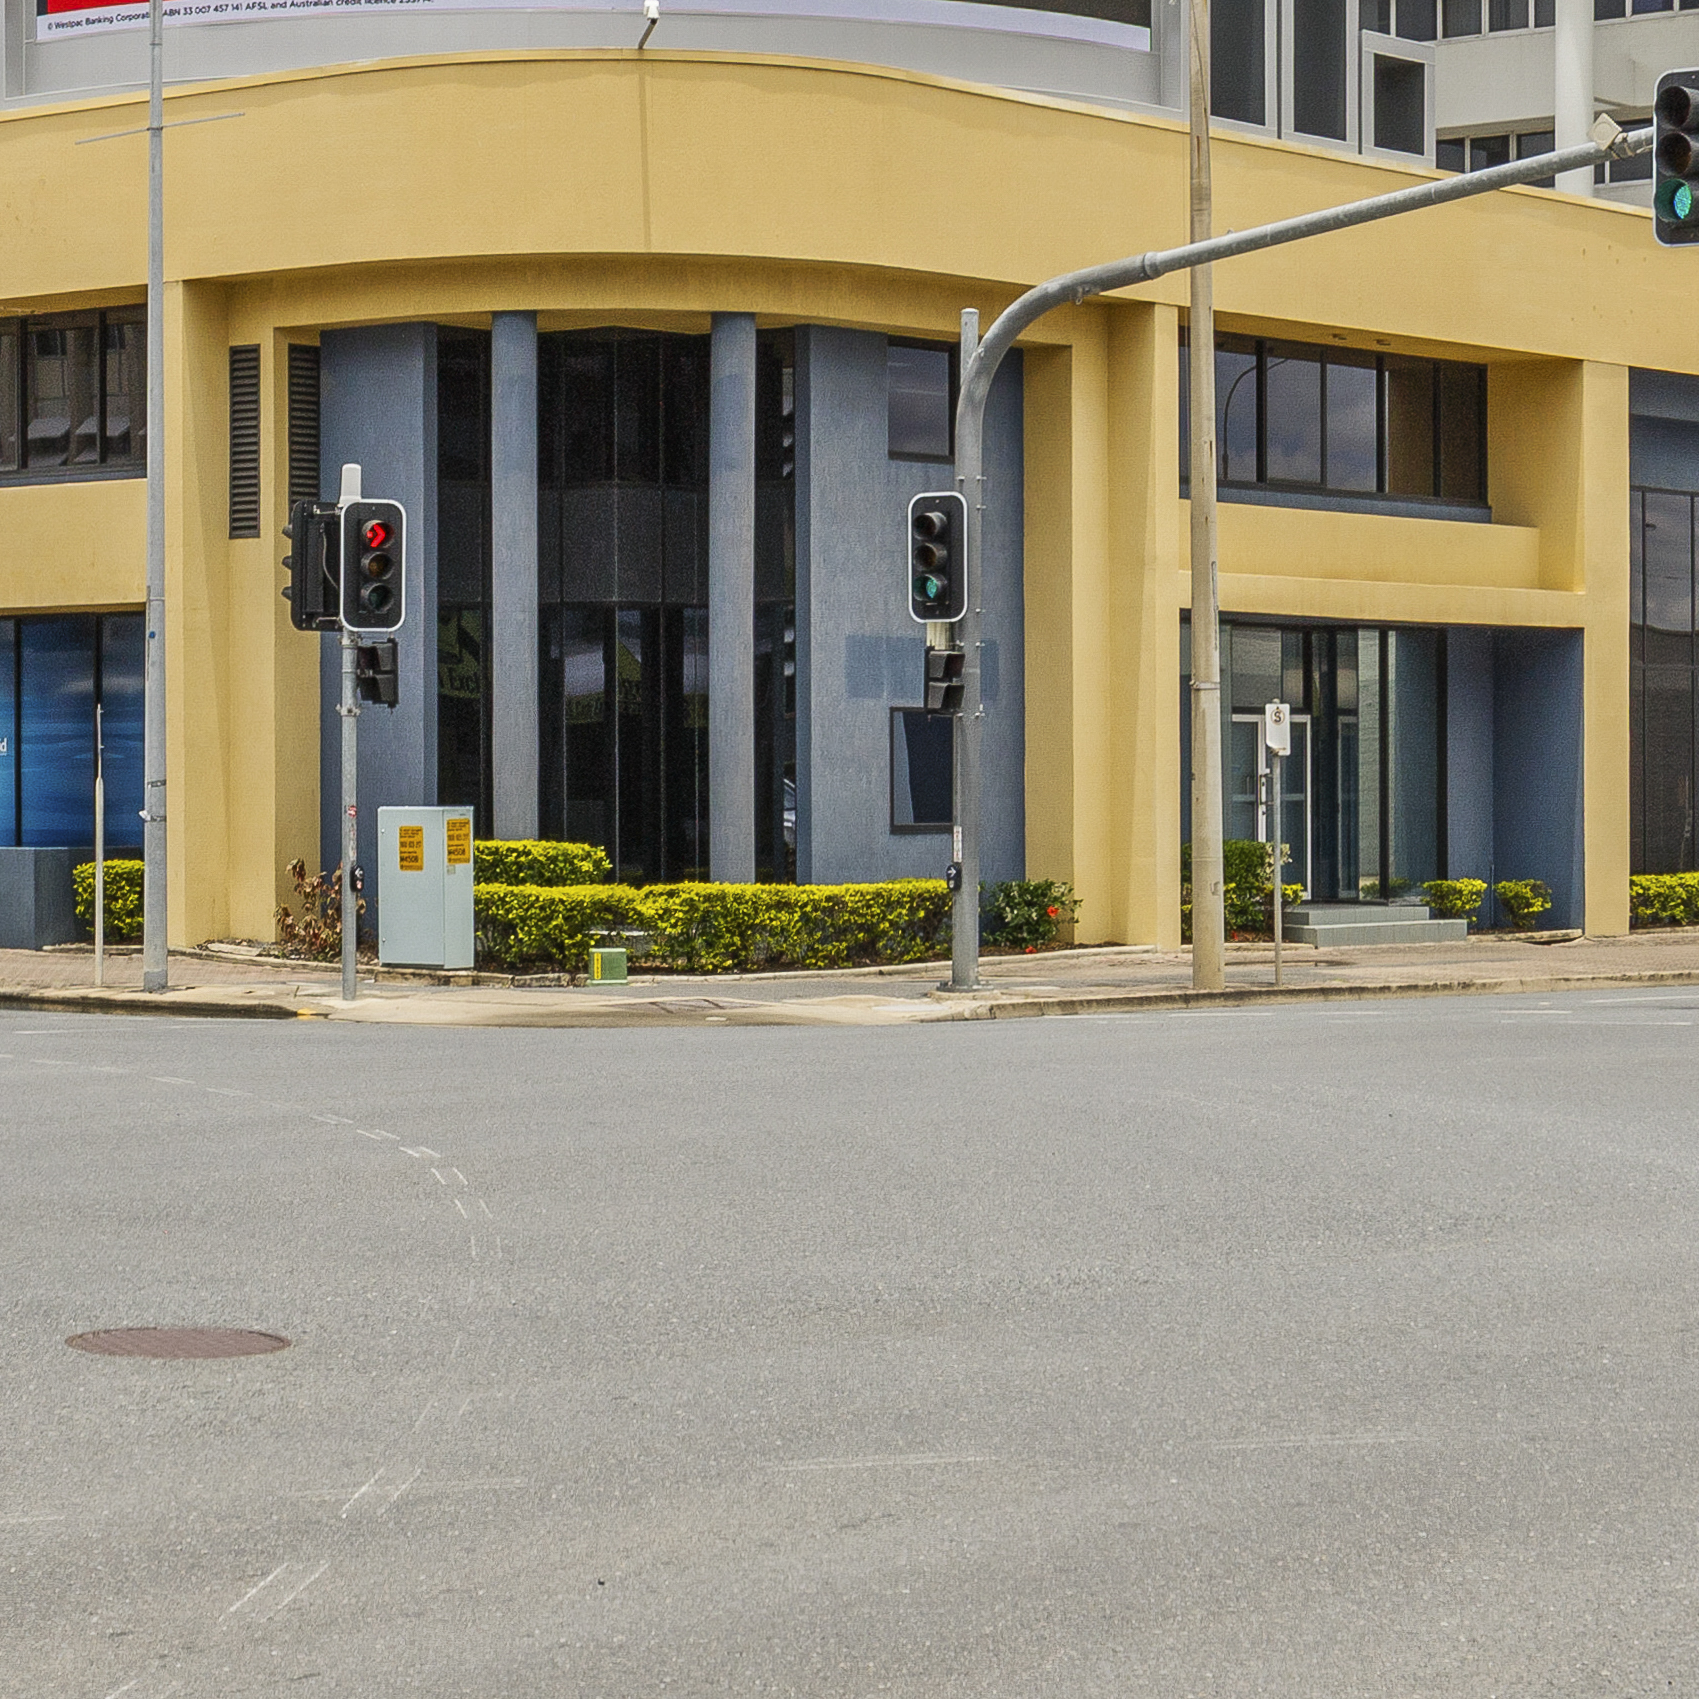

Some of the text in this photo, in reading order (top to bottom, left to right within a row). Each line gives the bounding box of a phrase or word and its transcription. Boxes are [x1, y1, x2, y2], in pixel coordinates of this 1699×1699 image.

[54, 19, 83, 30] Westpac
[85, 15, 114, 26] Banking
[116, 11, 150, 23] Corporat
[162, 7, 181, 17] ABN
[183, 7, 193, 15] 33
[195, 5, 211, 14] 007
[213, 4, 229, 13] 457
[232, 3, 243, 12] 141
[245, 2, 268, 11] AFSL
[270, 0, 287, 10] and
